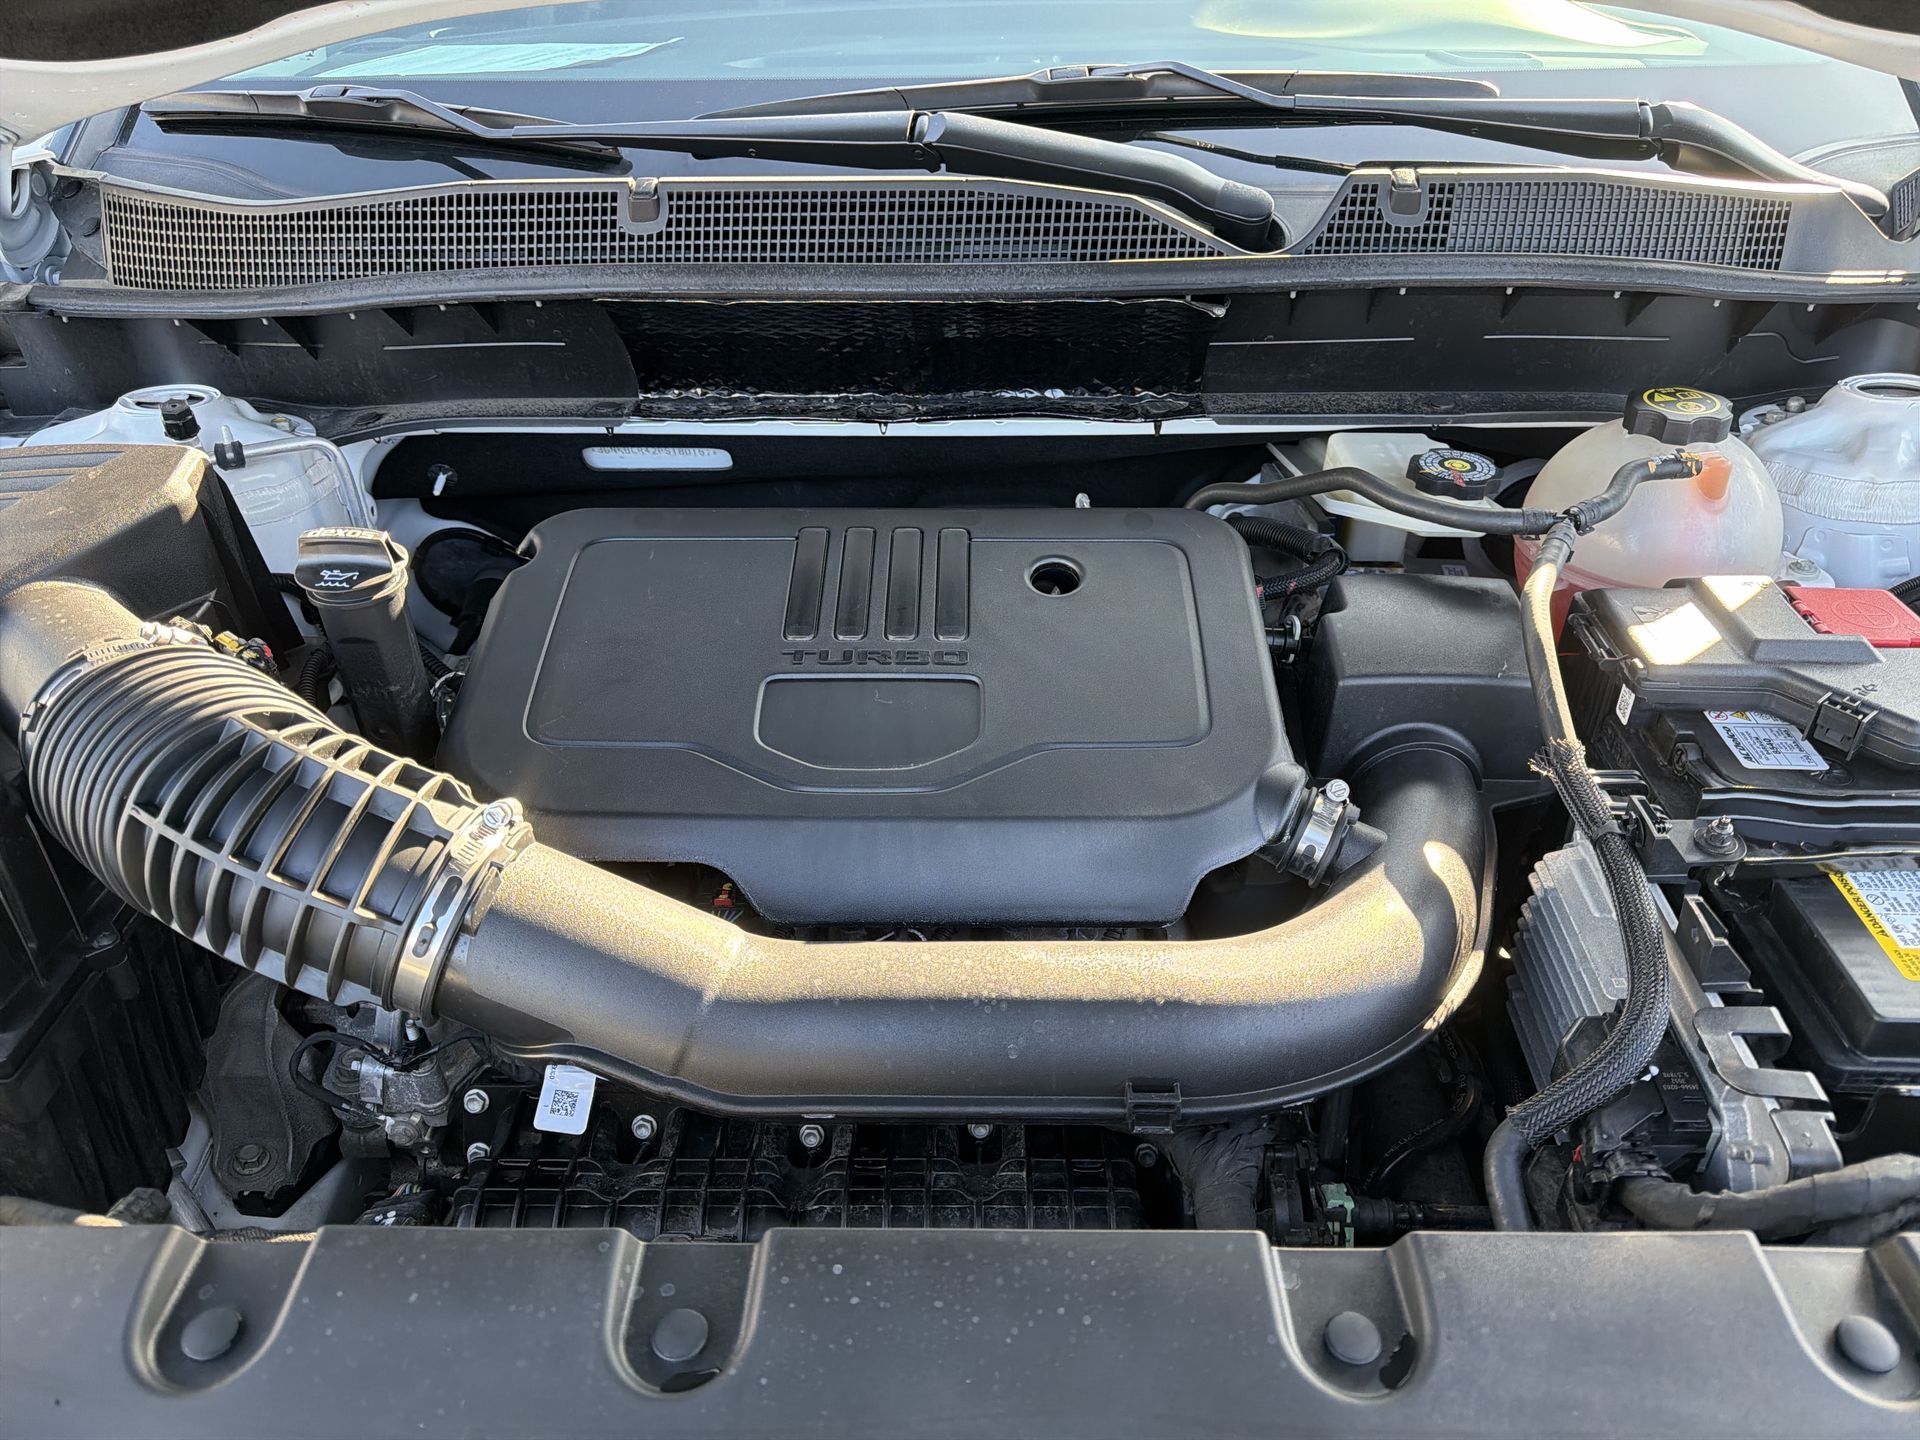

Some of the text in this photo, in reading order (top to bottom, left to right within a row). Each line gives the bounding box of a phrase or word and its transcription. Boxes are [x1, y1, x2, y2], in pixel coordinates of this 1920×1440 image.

[307, 528, 375, 539] dexos
[781, 649, 970, 666] TURBO
[1722, 726, 1756, 763] ACDelco
[1834, 869, 1884, 931] DANGER/POISO
